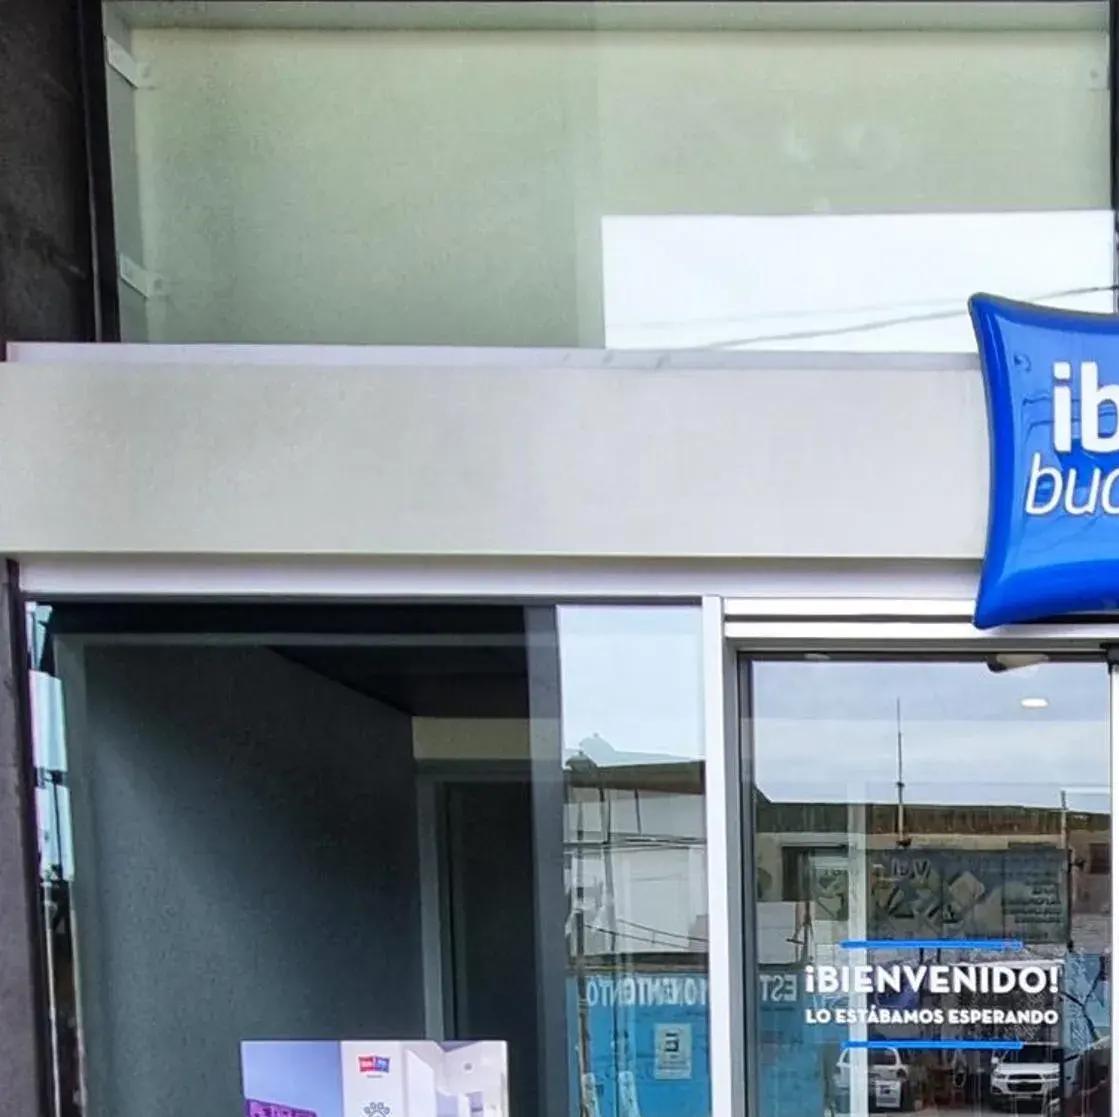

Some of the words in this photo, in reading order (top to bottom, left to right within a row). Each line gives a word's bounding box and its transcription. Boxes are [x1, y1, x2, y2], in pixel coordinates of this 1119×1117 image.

[804, 964, 1060, 995] ¡BIENVENIDO!
[805, 1010, 831, 1025] LO
[835, 1004, 944, 1026] ESTÁBAMOS
[949, 1009, 1060, 1026] ESPERANDO
